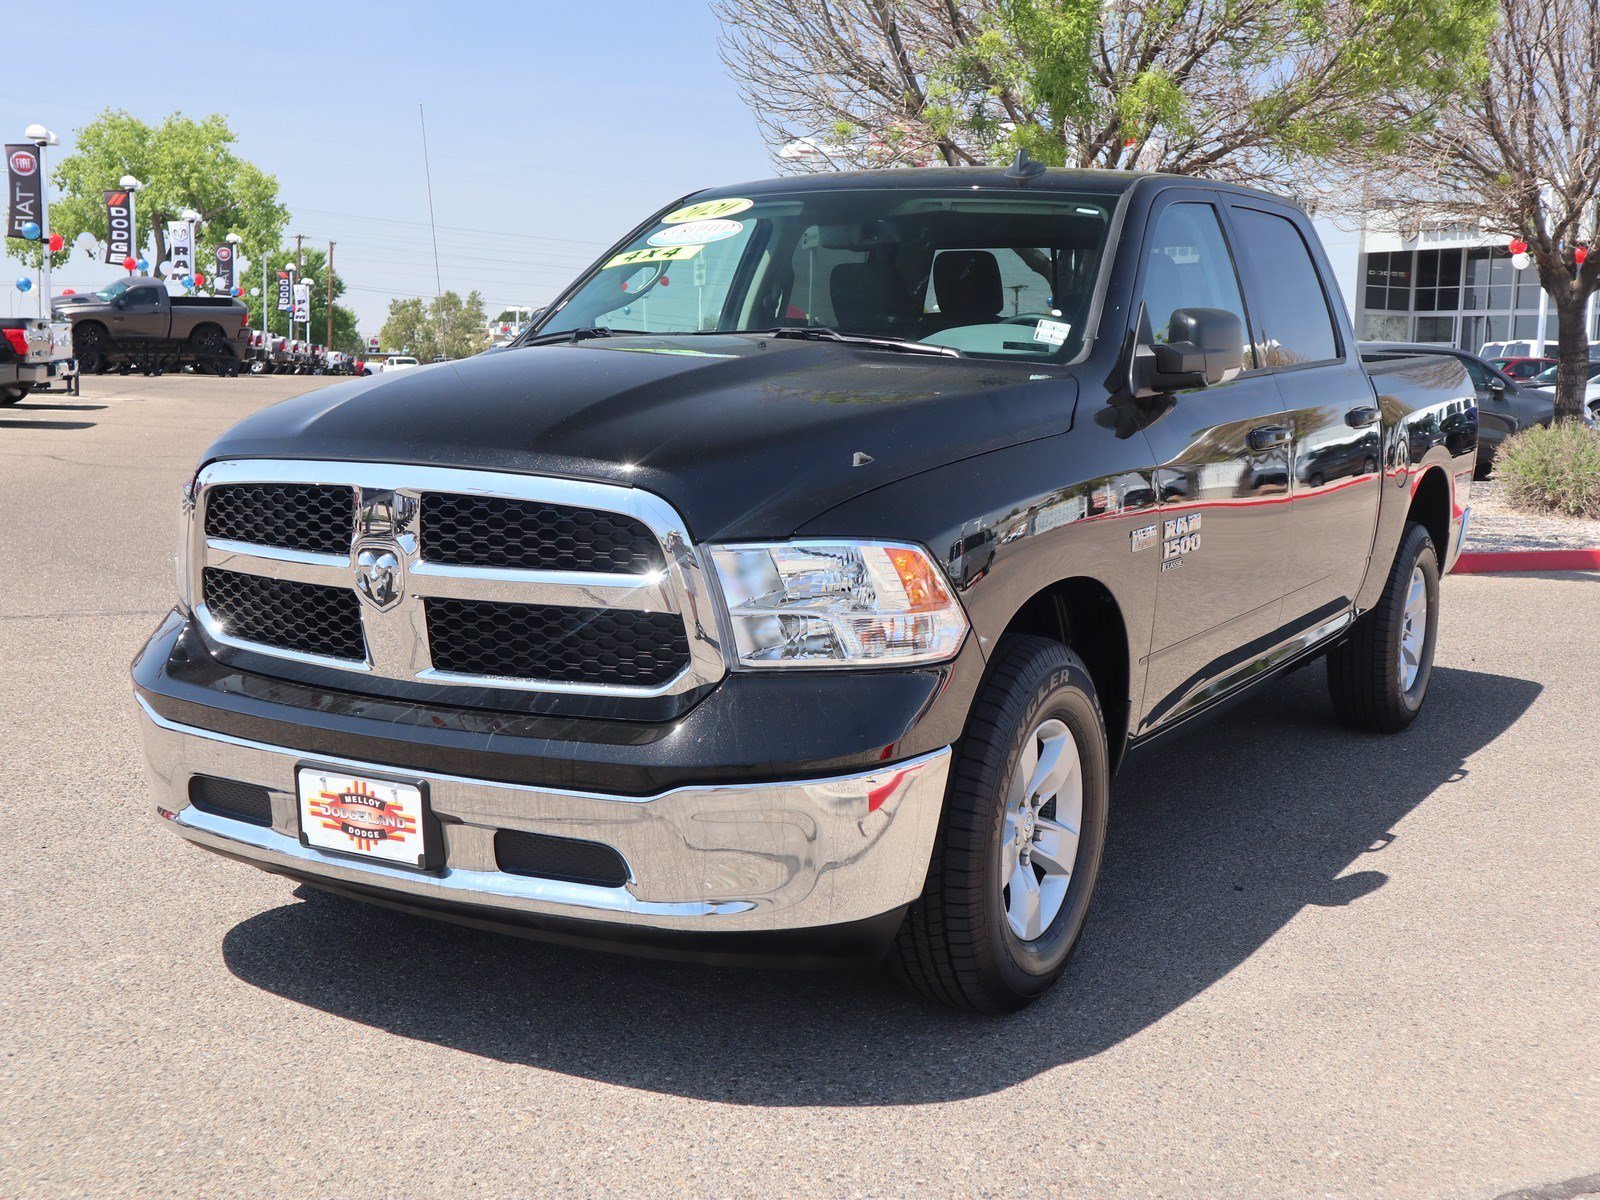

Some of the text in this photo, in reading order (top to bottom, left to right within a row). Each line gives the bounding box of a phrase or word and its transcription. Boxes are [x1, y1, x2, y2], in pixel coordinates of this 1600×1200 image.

[15, 156, 32, 170] FIAT
[110, 206, 129, 264] DODGE
[171, 246, 190, 281] RAM
[1163, 513, 1202, 539] RAM
[1162, 533, 1202, 560] 1500
[344, 795, 381, 808] MELLOY
[319, 803, 407, 829] DODGELAND
[348, 826, 380, 839] DODGE
